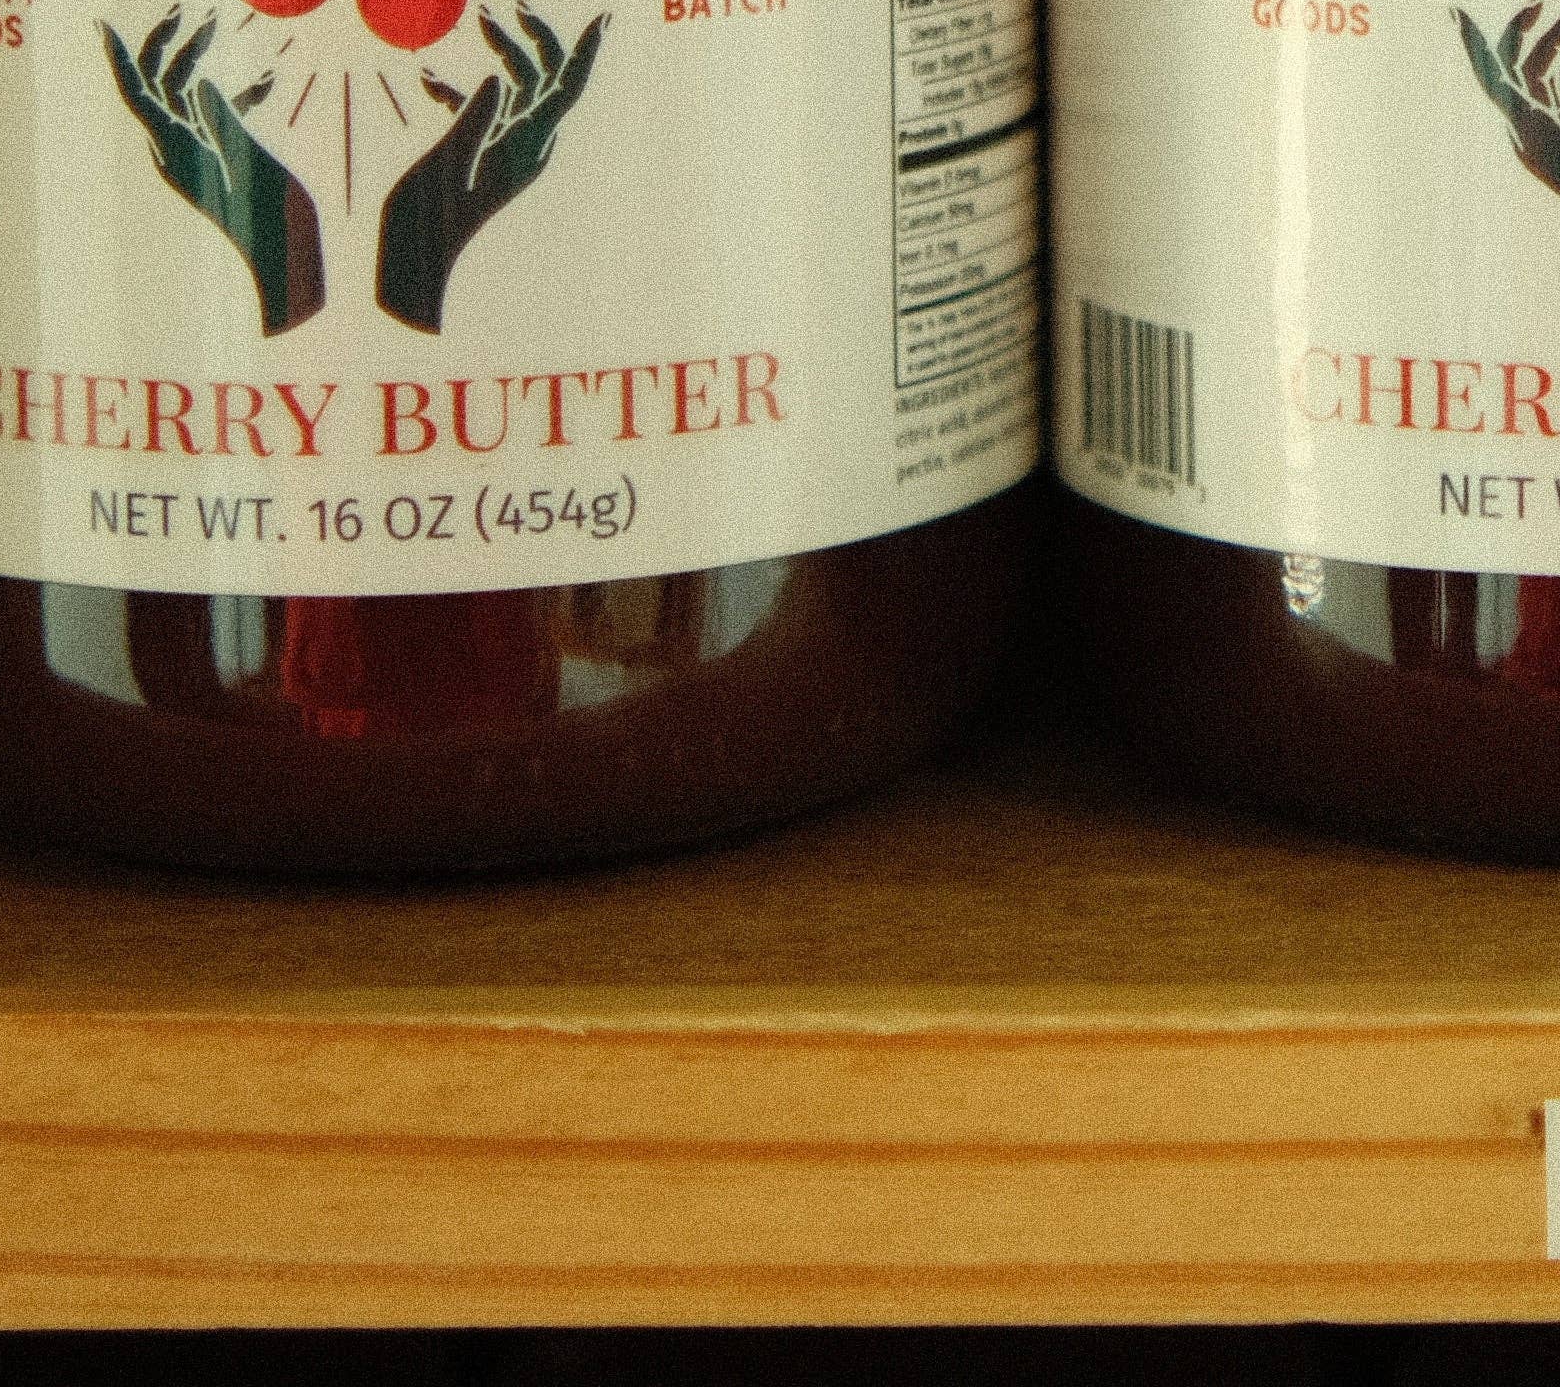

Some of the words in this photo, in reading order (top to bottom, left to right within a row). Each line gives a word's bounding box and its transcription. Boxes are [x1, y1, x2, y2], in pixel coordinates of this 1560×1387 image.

[373, 350, 788, 458] BUTTER
[89, 489, 177, 538] NET
[196, 495, 288, 543] WT.
[307, 498, 363, 542] 16
[382, 494, 455, 541] OZ
[474, 477, 639, 545] (454g)
[1437, 471, 1531, 519] NET
